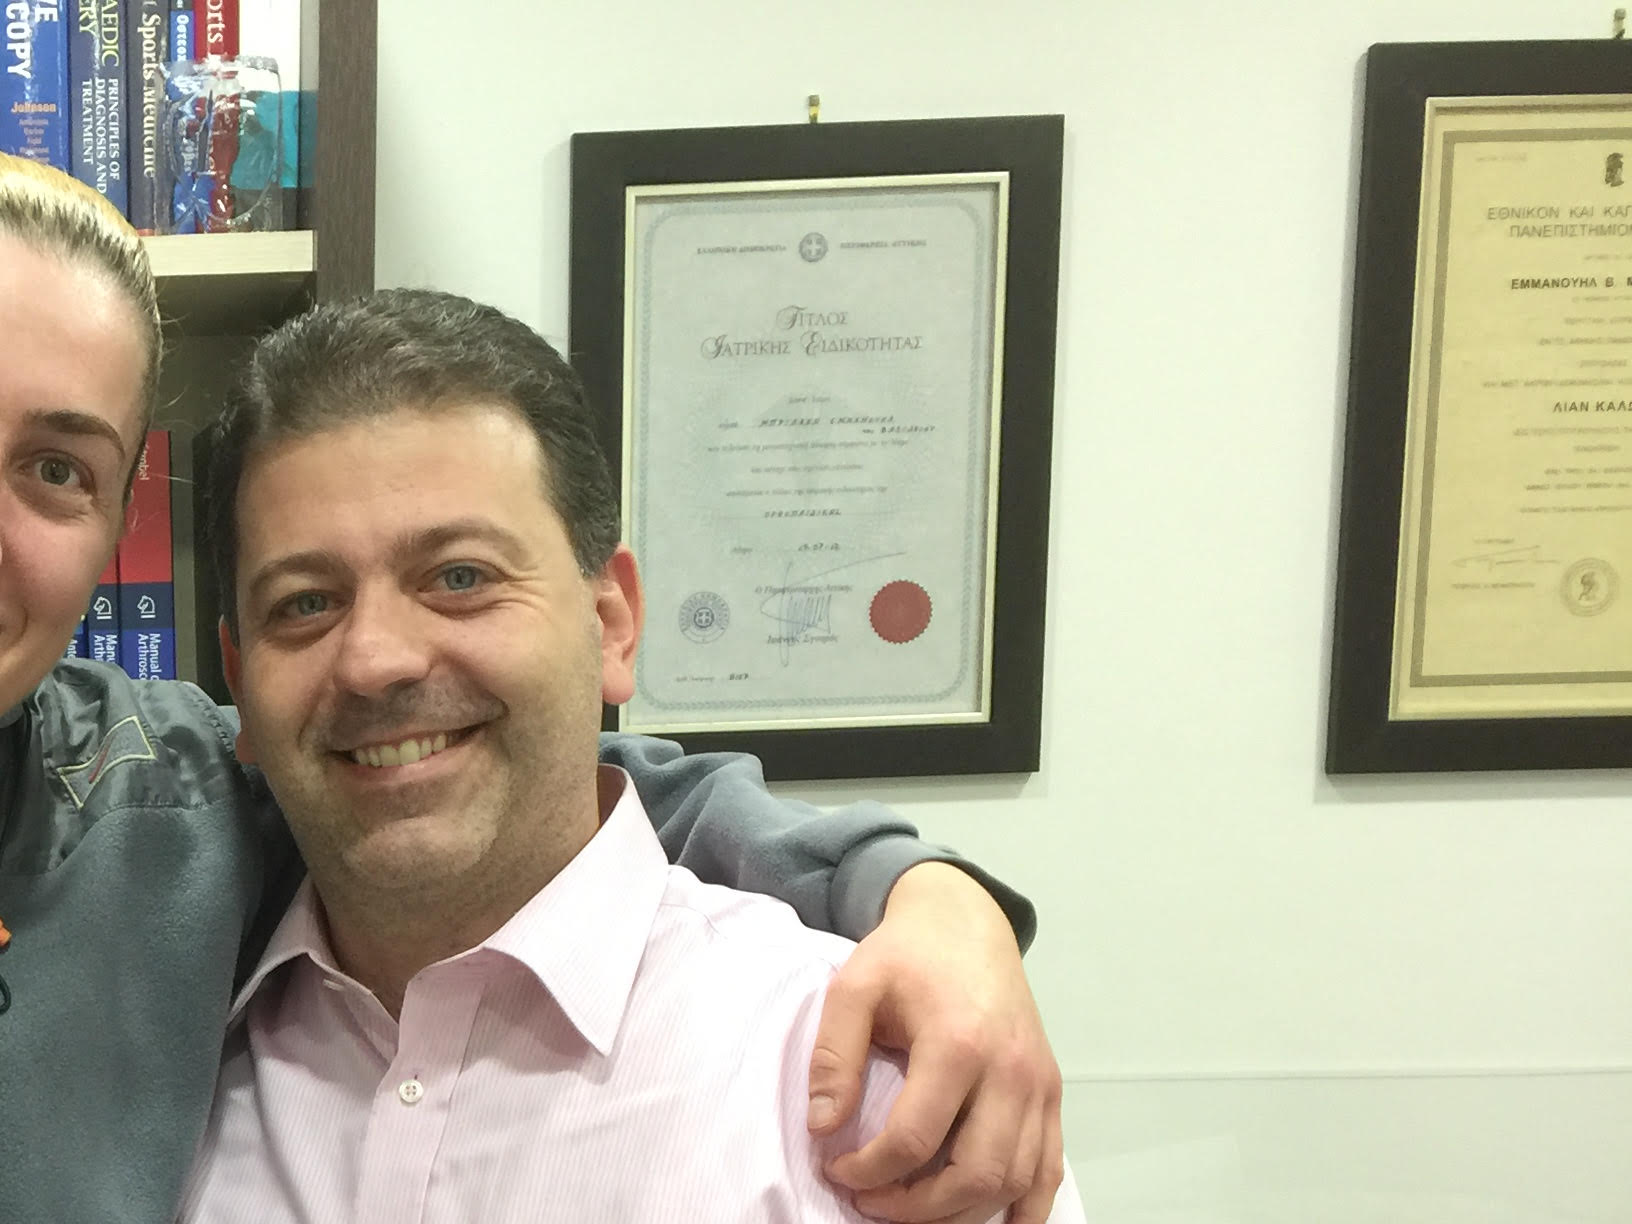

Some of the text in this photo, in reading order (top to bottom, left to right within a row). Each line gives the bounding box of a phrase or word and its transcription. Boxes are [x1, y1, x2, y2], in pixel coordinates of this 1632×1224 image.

[5, 2, 32, 80] COPY
[138, 12, 161, 81] Sports
[82, 78, 94, 165] TREATMENT
[95, 78, 107, 194] DIAGNOSIS AND
[108, 78, 121, 180] PRINCIPLES OF
[1487, 206, 1560, 221] ΕΘΝΙΚΟΝ
[1569, 206, 1595, 219] ΚΑΙ
[1511, 277, 1598, 290] ΕΜΜΑΝΟΥΗΛ
[800, 330, 924, 358] ΕΙΔΙΚΟΤΗΤΑΣ
[1553, 401, 1590, 414] ΛΙΑΝ
[149, 633, 161, 670] Manual
